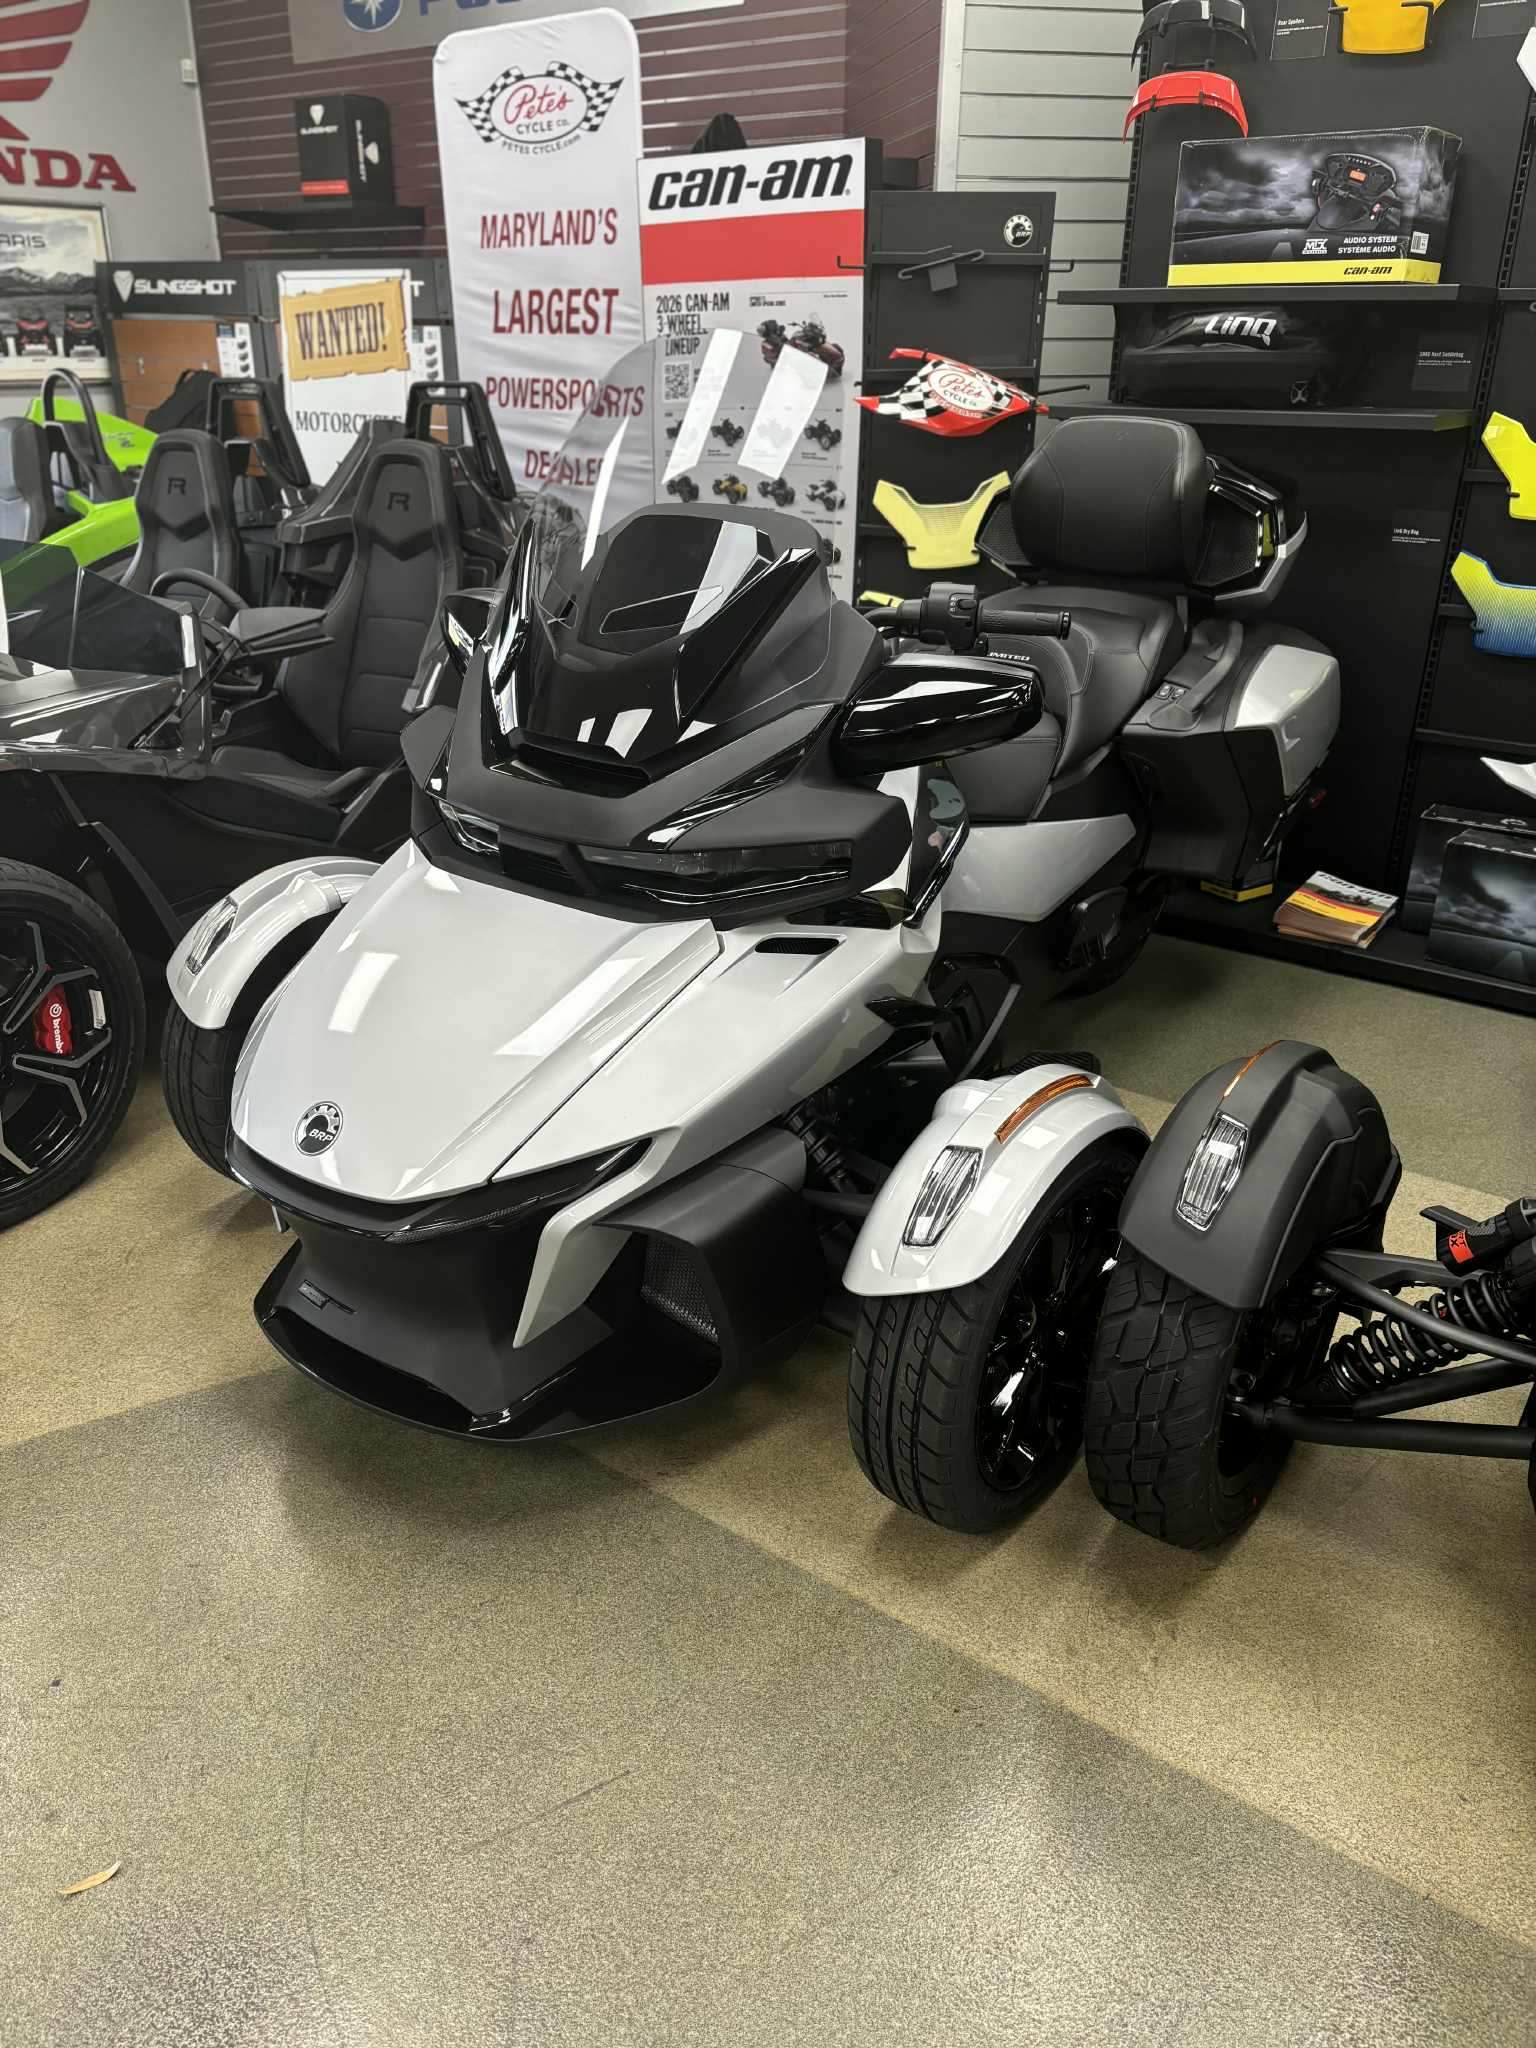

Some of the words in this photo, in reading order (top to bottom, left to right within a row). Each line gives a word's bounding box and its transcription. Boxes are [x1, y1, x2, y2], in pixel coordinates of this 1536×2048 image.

[504, 84, 573, 125] Pete's
[516, 121, 553, 135] CYCLE
[502, 140, 530, 155] PETES
[648, 154, 853, 211] can-am
[480, 207, 617, 249] MARYLAND'S
[1304, 238, 1328, 251] MTX
[1338, 245, 1371, 254] SYSTÈME
[1372, 245, 1396, 253] AUDIO
[1344, 266, 1393, 275] can-am
[134, 279, 237, 295] SLINGSHOT
[493, 288, 619, 335] LARGEST
[656, 294, 682, 314] 2026
[685, 292, 730, 312] CAN-AM
[295, 302, 388, 360] WANTED!
[665, 337, 701, 357] LINEUP
[485, 376, 645, 418] POWERSPORTS
[943, 389, 967, 405] CYCLE
[308, 1128, 334, 1142] BRP
